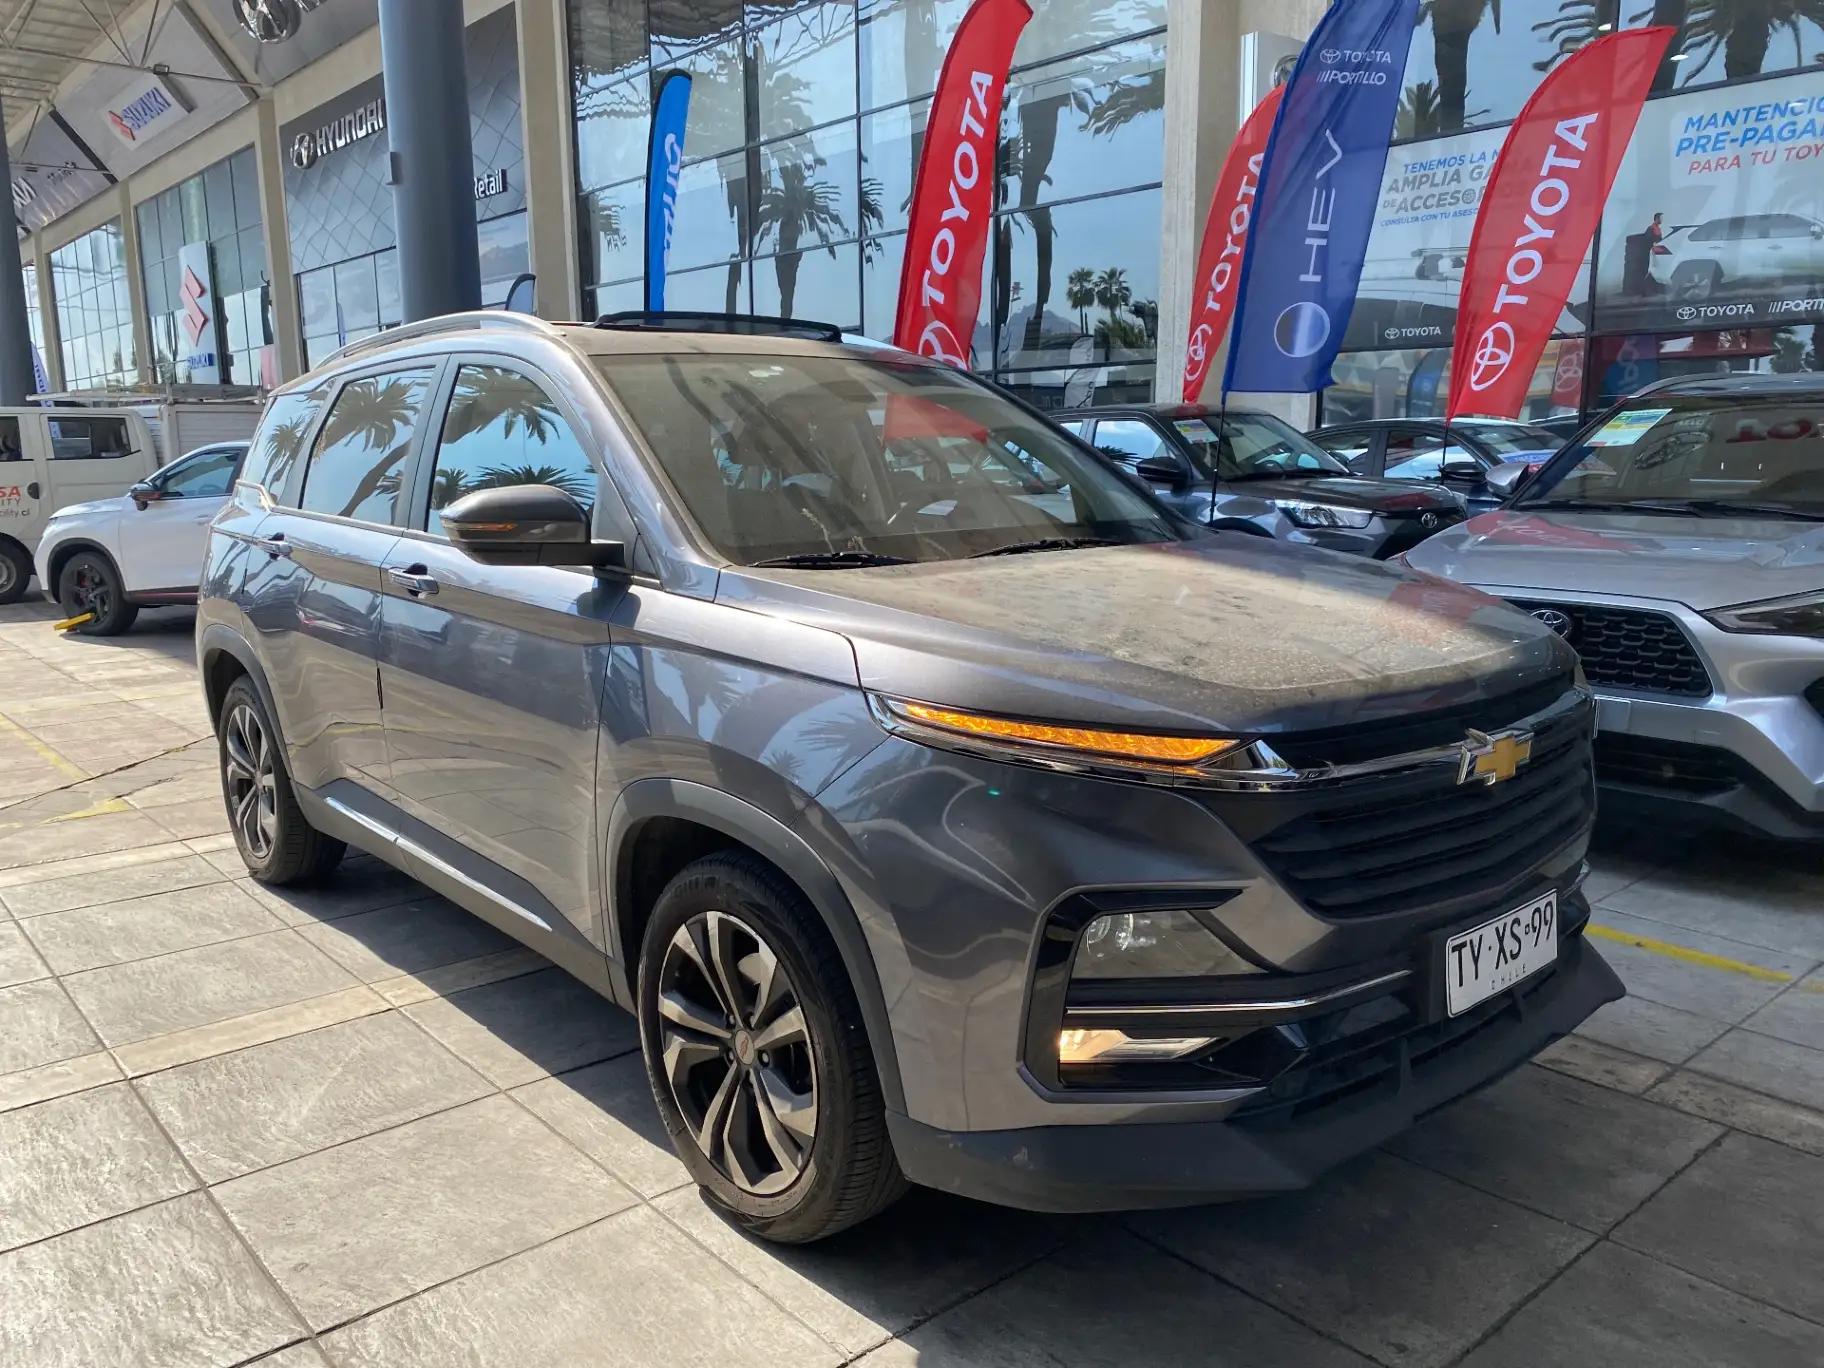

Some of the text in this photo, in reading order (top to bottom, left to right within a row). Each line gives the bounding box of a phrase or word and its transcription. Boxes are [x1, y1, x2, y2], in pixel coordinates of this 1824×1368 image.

[1343, 49, 1391, 63] TOYOTA
[315, 98, 384, 157] HYUNDAI
[1404, 154, 1466, 175] TENEMOS
[1469, 151, 1487, 164] LA
[1688, 154, 1741, 175] PARA
[1751, 150, 1776, 166] TU
[921, 71, 993, 307] TOYOTA
[1386, 168, 1461, 194] AMPLIA
[1299, 128, 1342, 282] HEV
[1383, 199, 1397, 209] DE
[1492, 112, 1599, 314] TOYOTA
[1381, 215, 1420, 227] CONSULTA
[1420, 213, 1439, 222] CON
[1440, 211, 1452, 219] TU
[1204, 152, 1265, 314] TOYOTA
[1700, 303, 1755, 317] TOYOTA
[1401, 326, 1441, 337] TOYOTA
[1491, 963, 1526, 990] CHILE
